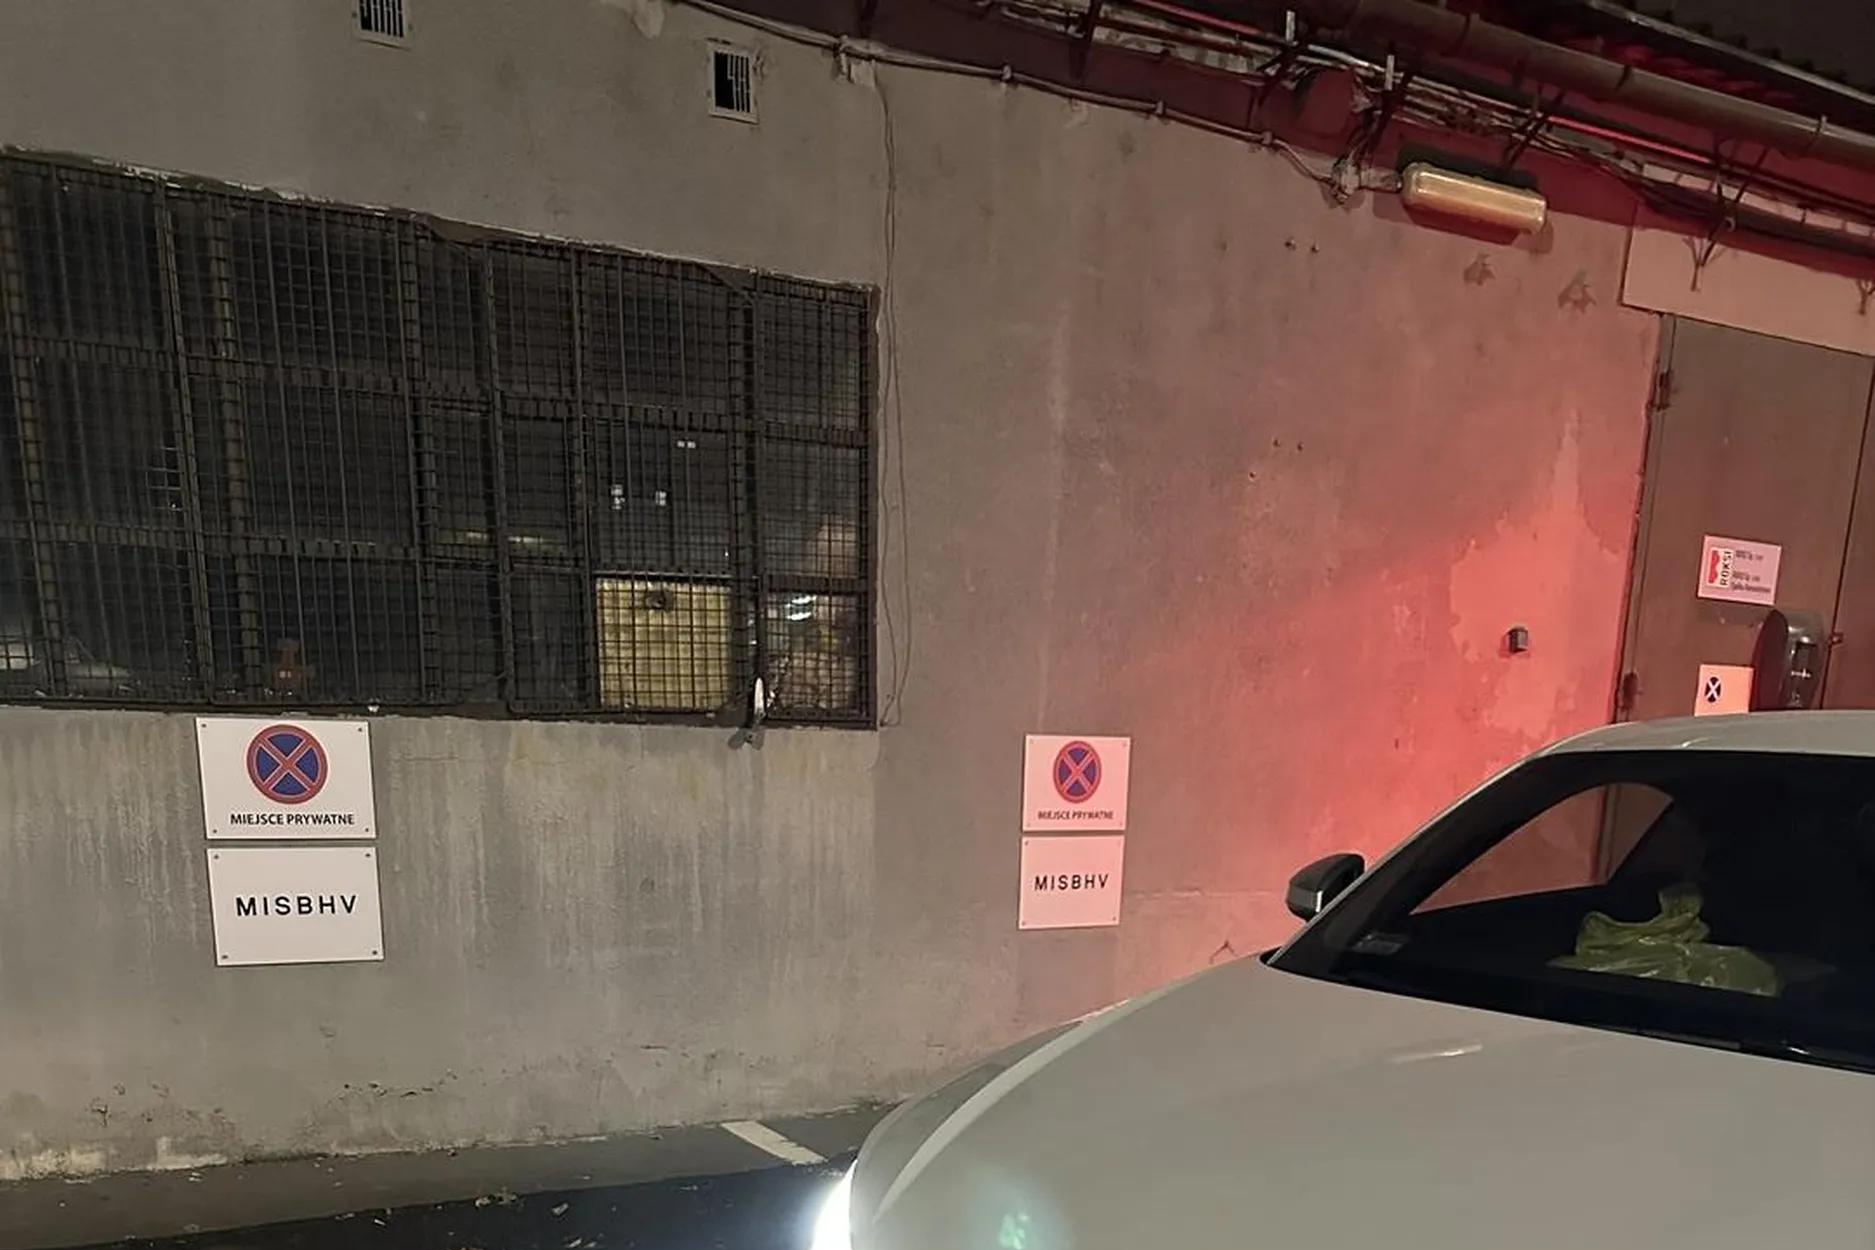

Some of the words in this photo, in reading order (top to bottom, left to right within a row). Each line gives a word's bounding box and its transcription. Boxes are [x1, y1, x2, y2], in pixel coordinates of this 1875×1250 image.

[230, 813, 284, 825] MIEJSCE
[286, 813, 355, 825] PRYWATNE
[1034, 873, 1109, 890] MISBHV
[235, 895, 357, 916] MISBHV
